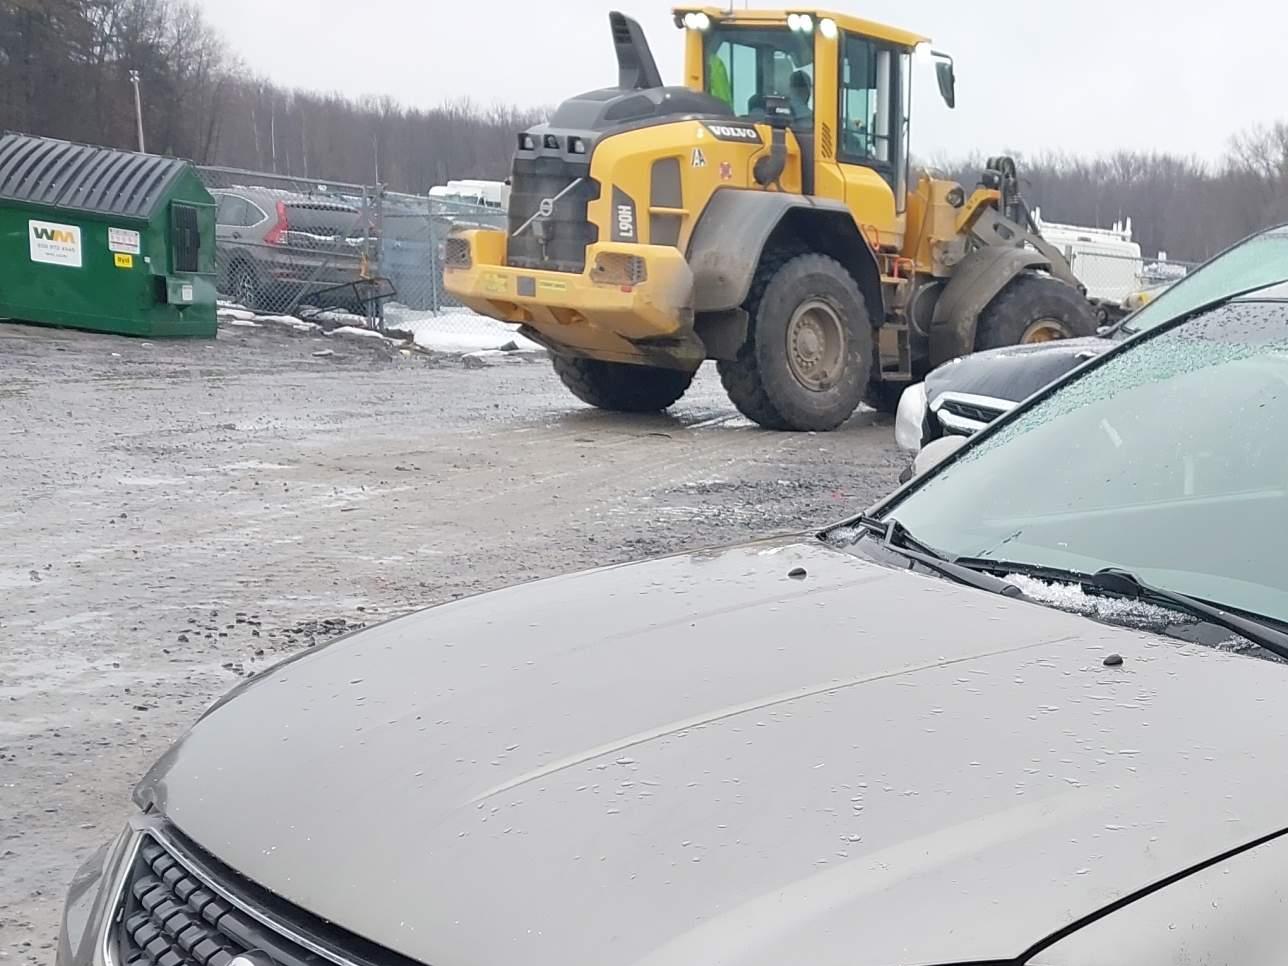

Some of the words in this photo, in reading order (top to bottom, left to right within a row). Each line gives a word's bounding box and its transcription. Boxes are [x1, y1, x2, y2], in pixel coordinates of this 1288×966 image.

[708, 125, 757, 138] VOLVO
[617, 205, 633, 238] L90H
[33, 226, 76, 244] WM
